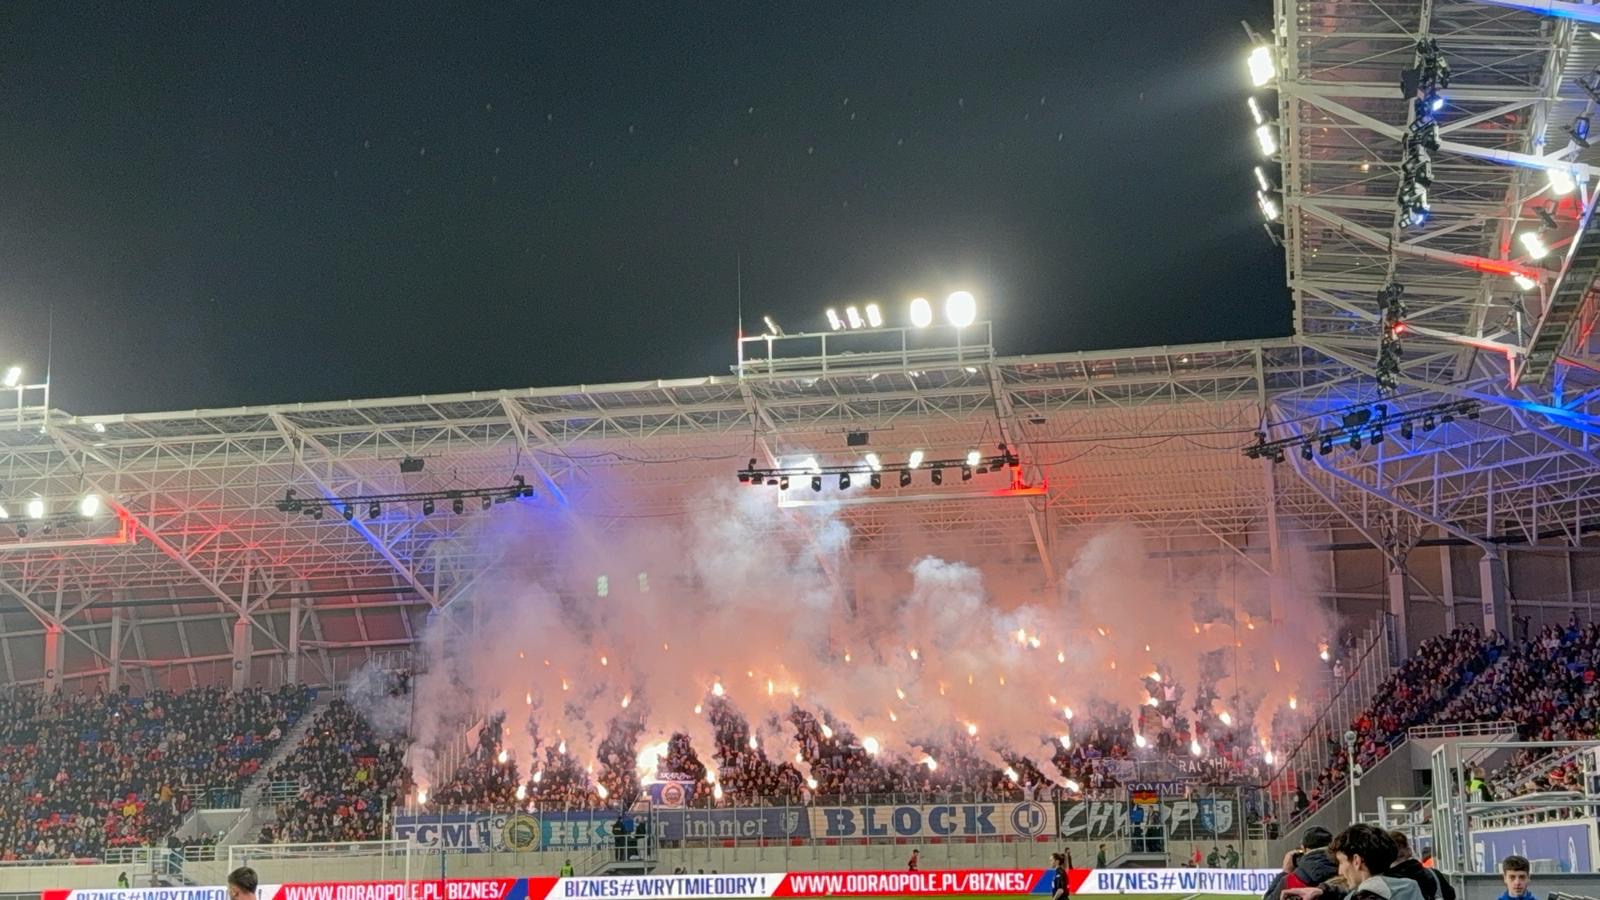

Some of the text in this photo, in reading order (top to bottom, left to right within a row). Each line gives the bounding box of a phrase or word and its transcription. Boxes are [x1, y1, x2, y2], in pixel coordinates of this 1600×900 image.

[1485, 603, 1492, 615] E
[46, 669, 54, 679] C
[234, 660, 242, 671] C
[686, 814, 767, 837] immer
[824, 806, 996, 836] BLOCK
[395, 824, 472, 847] FCM
[790, 873, 1033, 893] WWW.ODRAOPOLE.PL/BIZNES/
